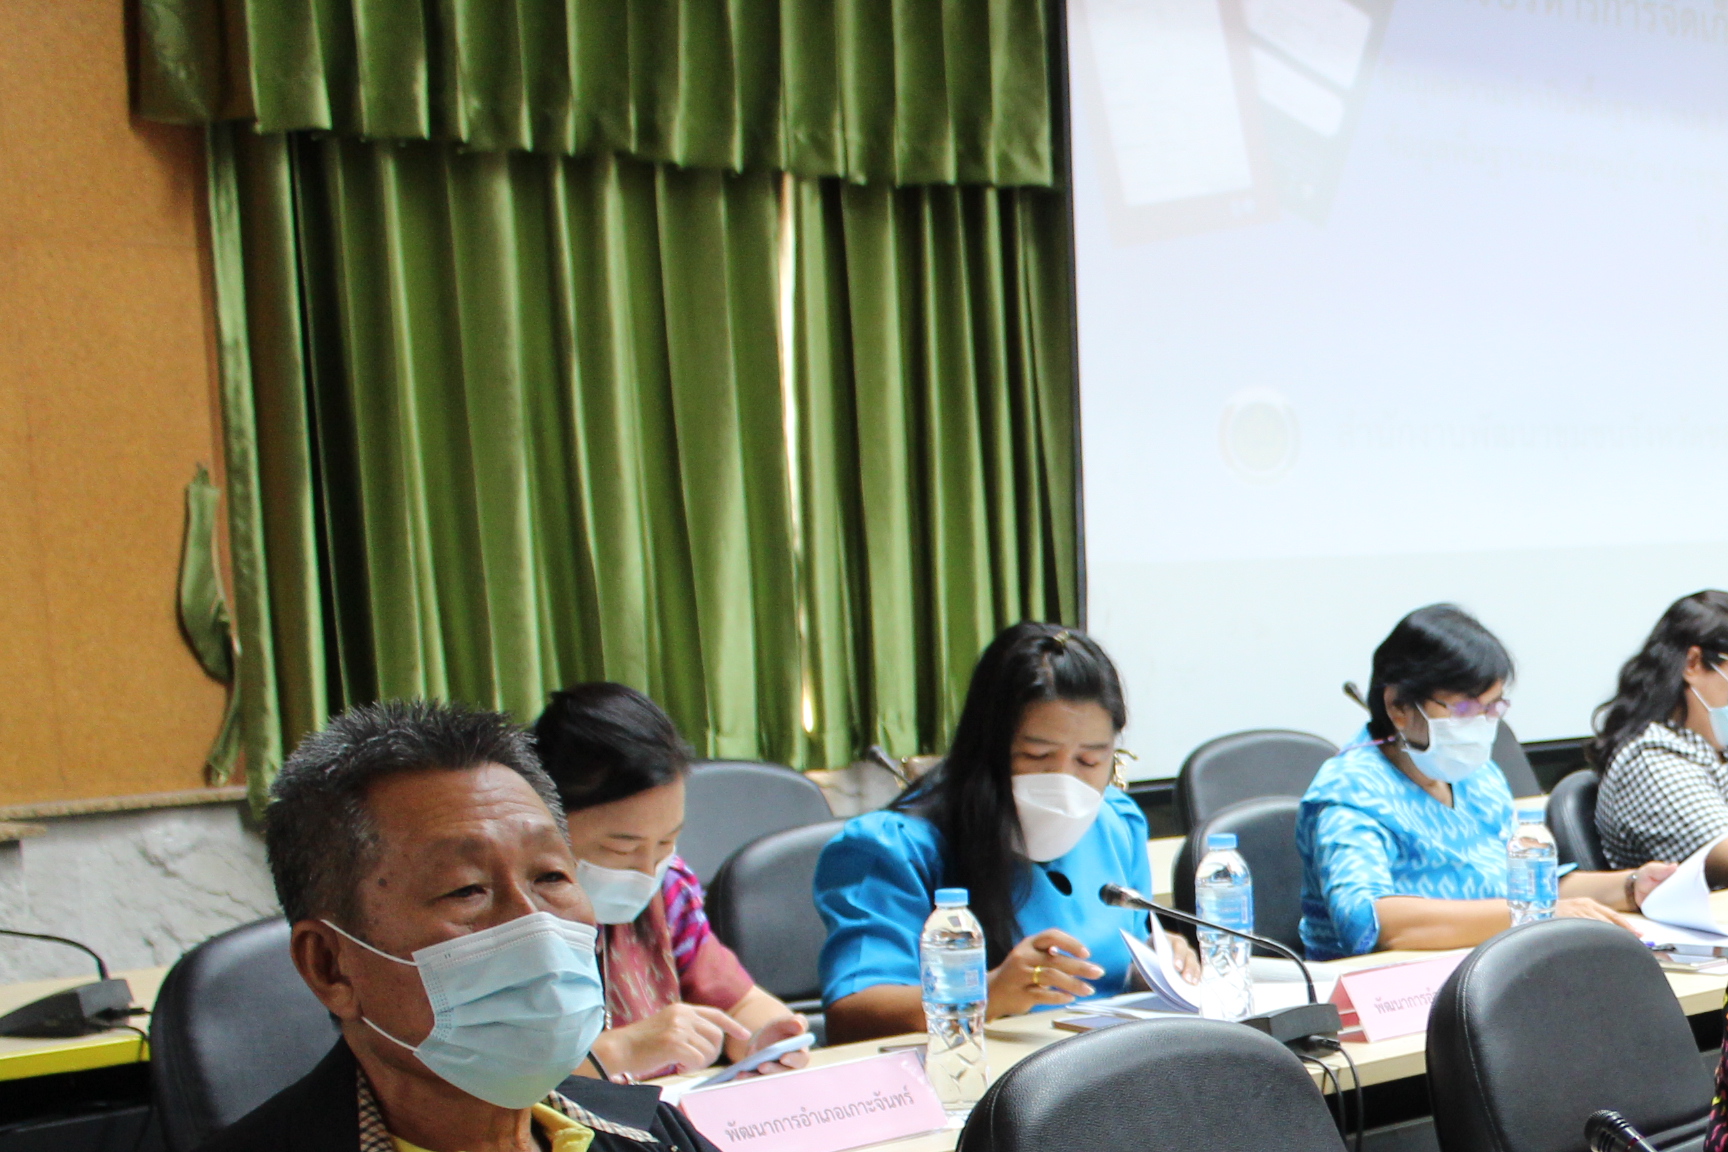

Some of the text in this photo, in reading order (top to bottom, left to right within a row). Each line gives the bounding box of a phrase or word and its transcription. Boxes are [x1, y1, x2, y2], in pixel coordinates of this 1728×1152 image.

[725, 1085, 915, 1143] พัฒนาการอำเภอเกาะจันทร์
